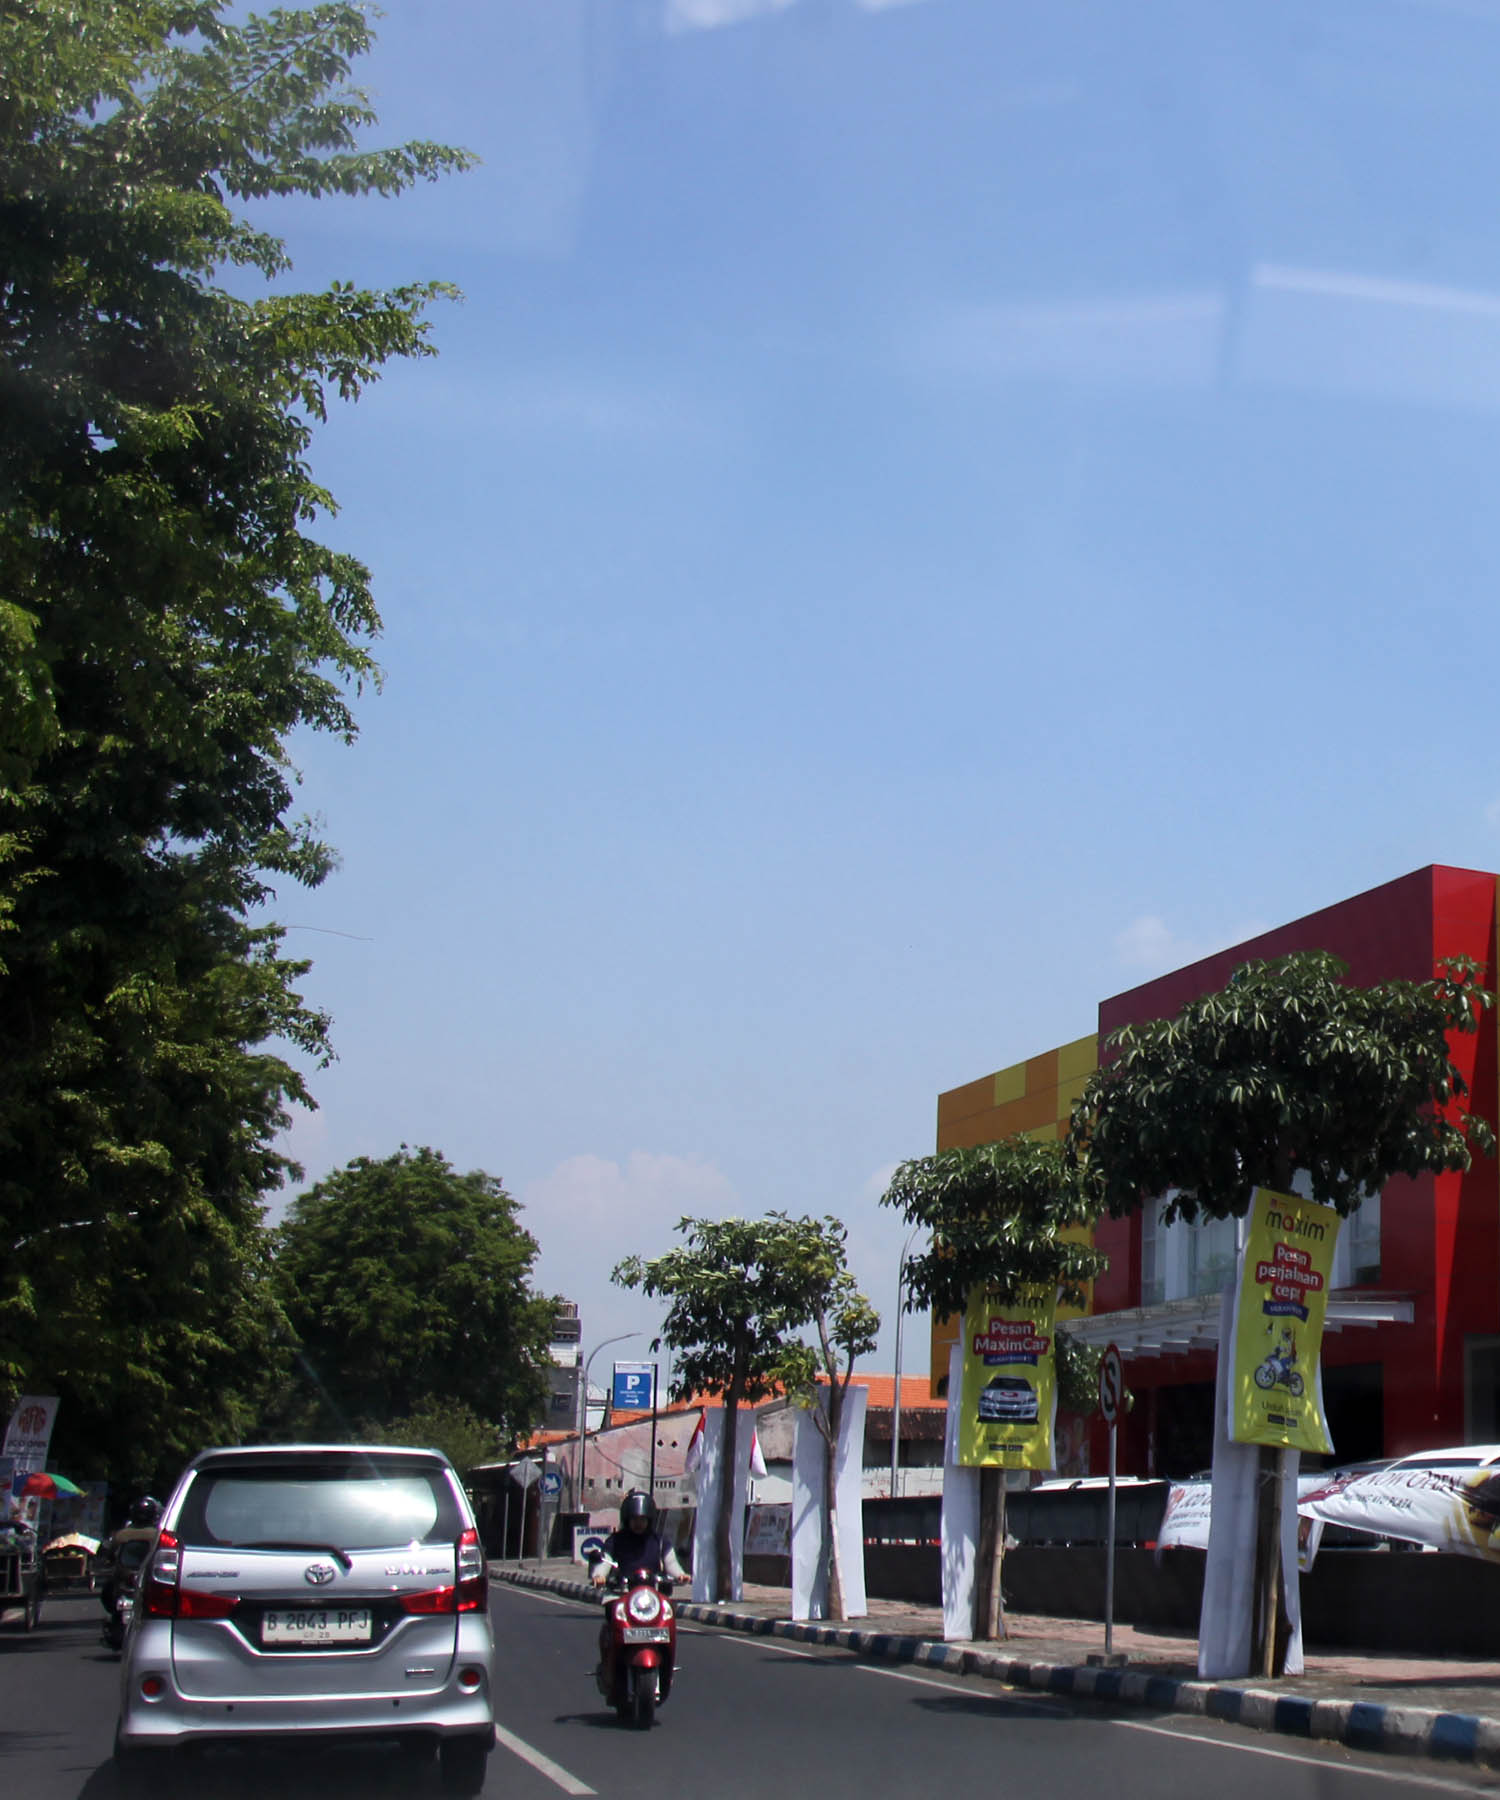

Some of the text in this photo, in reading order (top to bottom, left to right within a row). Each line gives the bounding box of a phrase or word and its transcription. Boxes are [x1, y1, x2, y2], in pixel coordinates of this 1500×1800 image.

[991, 1320, 1032, 1335] Pesan
[975, 1337, 1049, 1351] MaximCar
[626, 1375, 641, 1390] P
[267, 1613, 277, 1630] B
[338, 1611, 369, 1629] PFJ
